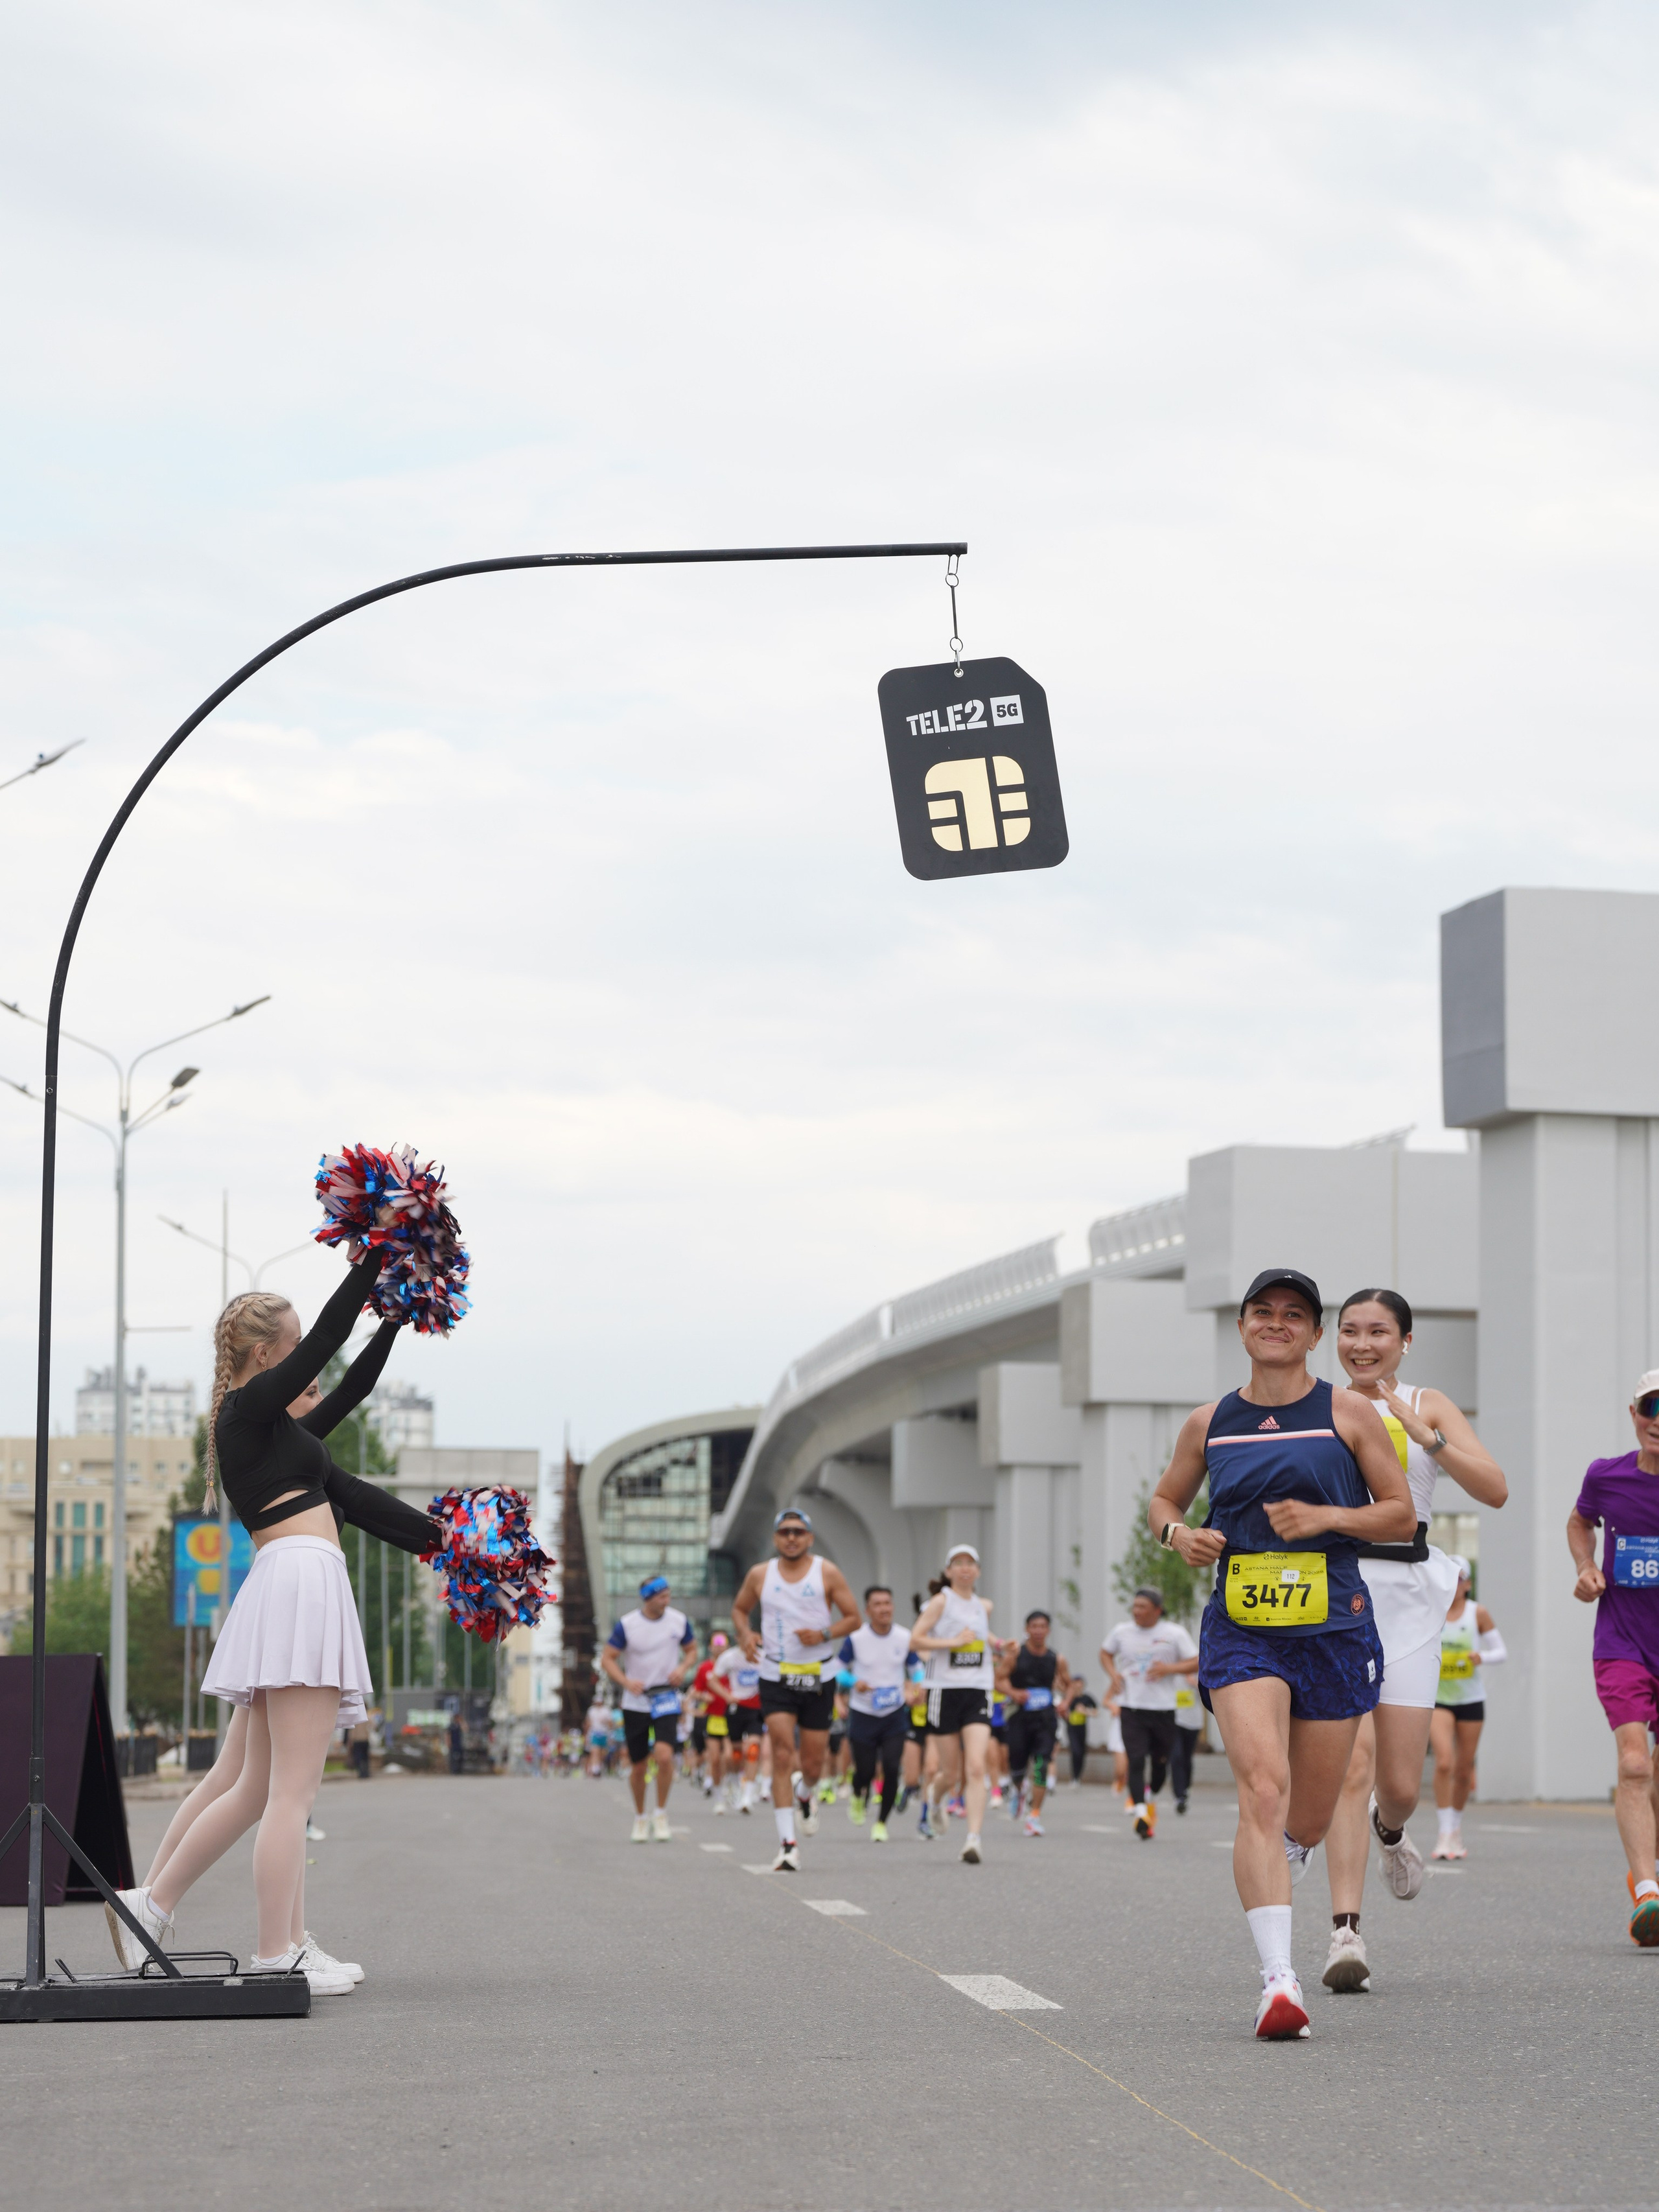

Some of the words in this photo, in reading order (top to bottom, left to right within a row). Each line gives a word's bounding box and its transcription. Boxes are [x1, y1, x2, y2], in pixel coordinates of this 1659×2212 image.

[906, 699, 988, 736] TELE2
[997, 703, 1018, 717] 5G
[1618, 1541, 1624, 1549] C
[1233, 1563, 1240, 1575] B
[1242, 1583, 1312, 1608] 3477
